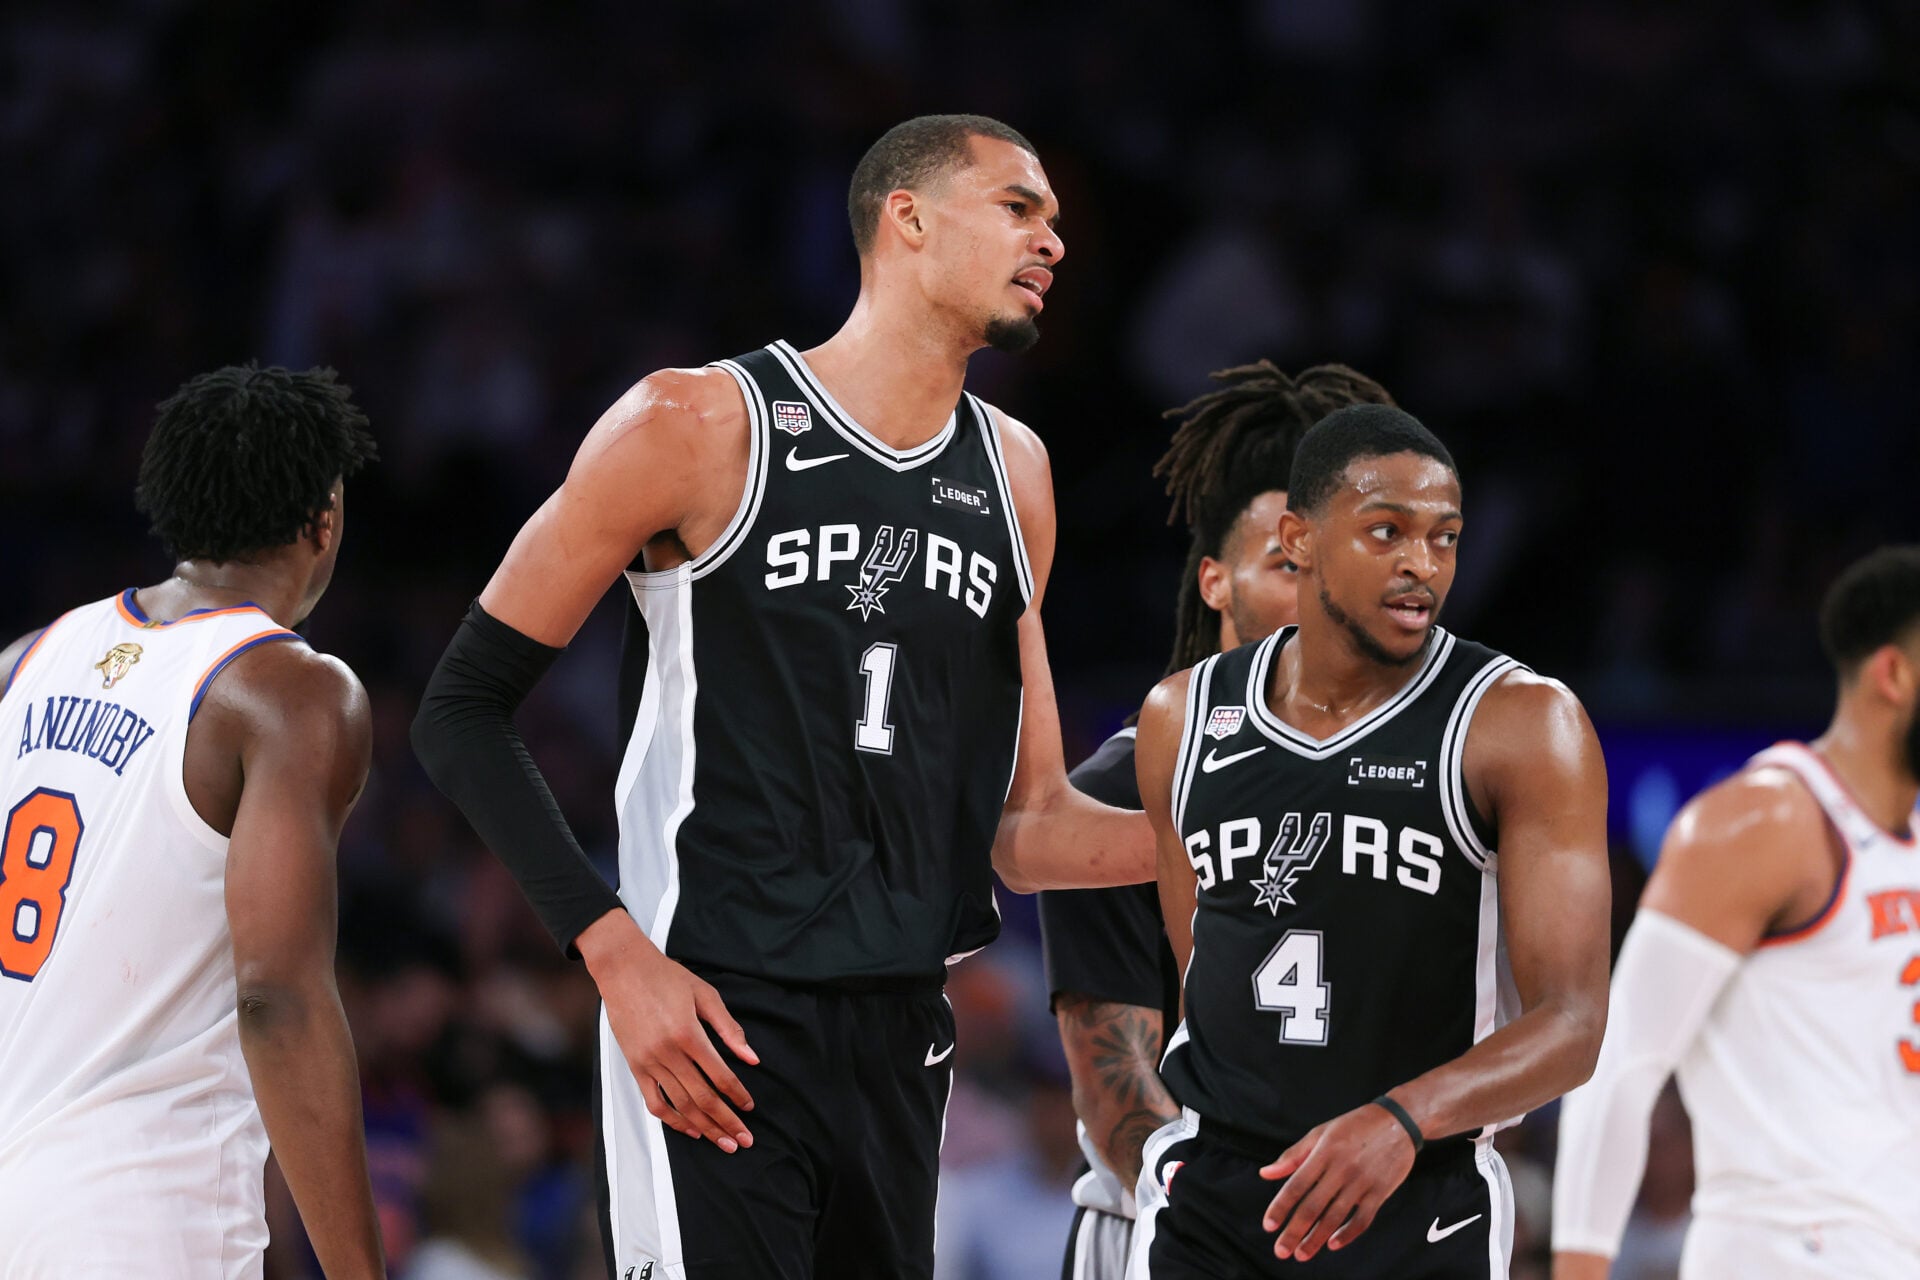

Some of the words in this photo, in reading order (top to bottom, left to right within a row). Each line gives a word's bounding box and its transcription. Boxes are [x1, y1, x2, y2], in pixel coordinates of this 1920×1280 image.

[777, 405, 806, 415] USA
[778, 418, 809, 428] 250
[940, 486, 981, 507] LEDGER
[765, 523, 998, 622] SPURS
[17, 695, 155, 777] ANUNOBY
[855, 641, 897, 756] 1
[1214, 710, 1240, 719] USA
[1358, 765, 1416, 780] LEDGER
[0, 786, 85, 983] 8
[1184, 812, 1444, 917] SPURS
[1251, 928, 1332, 1047] 4
